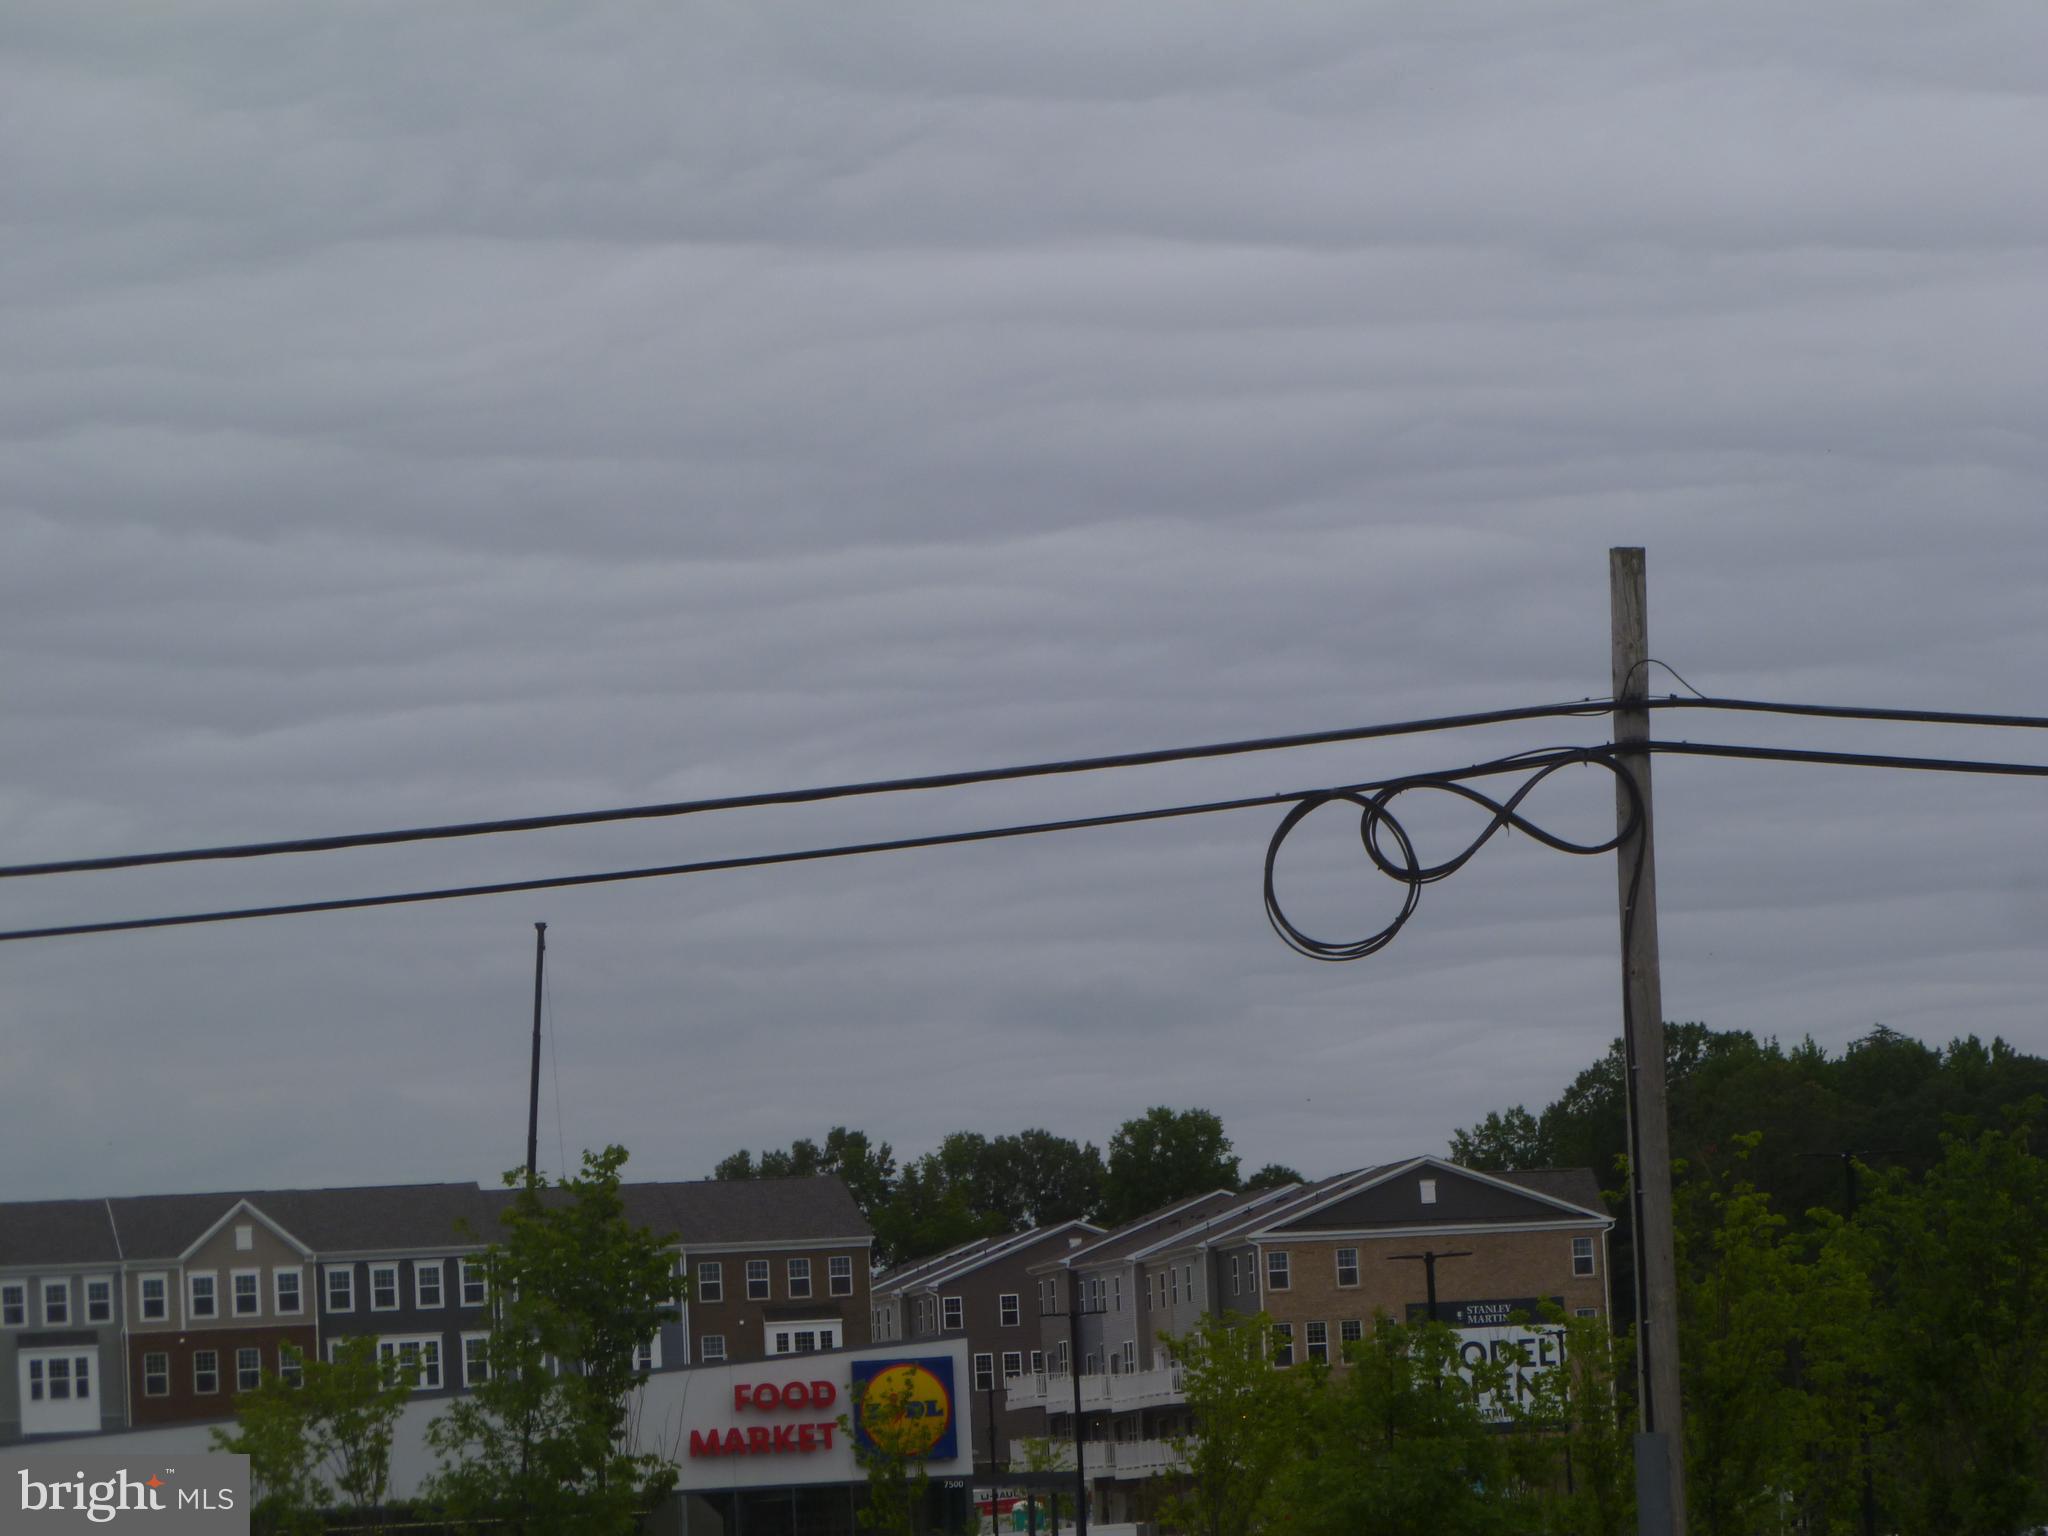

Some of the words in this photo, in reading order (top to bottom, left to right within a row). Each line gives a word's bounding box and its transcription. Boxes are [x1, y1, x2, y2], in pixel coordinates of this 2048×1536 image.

[1466, 1304, 1511, 1314] STANLEY
[1446, 1338, 1557, 1370] ODEL
[734, 1380, 837, 1411] FOOD
[689, 1422, 838, 1457] MARKET
[944, 1480, 964, 1489] 7500
